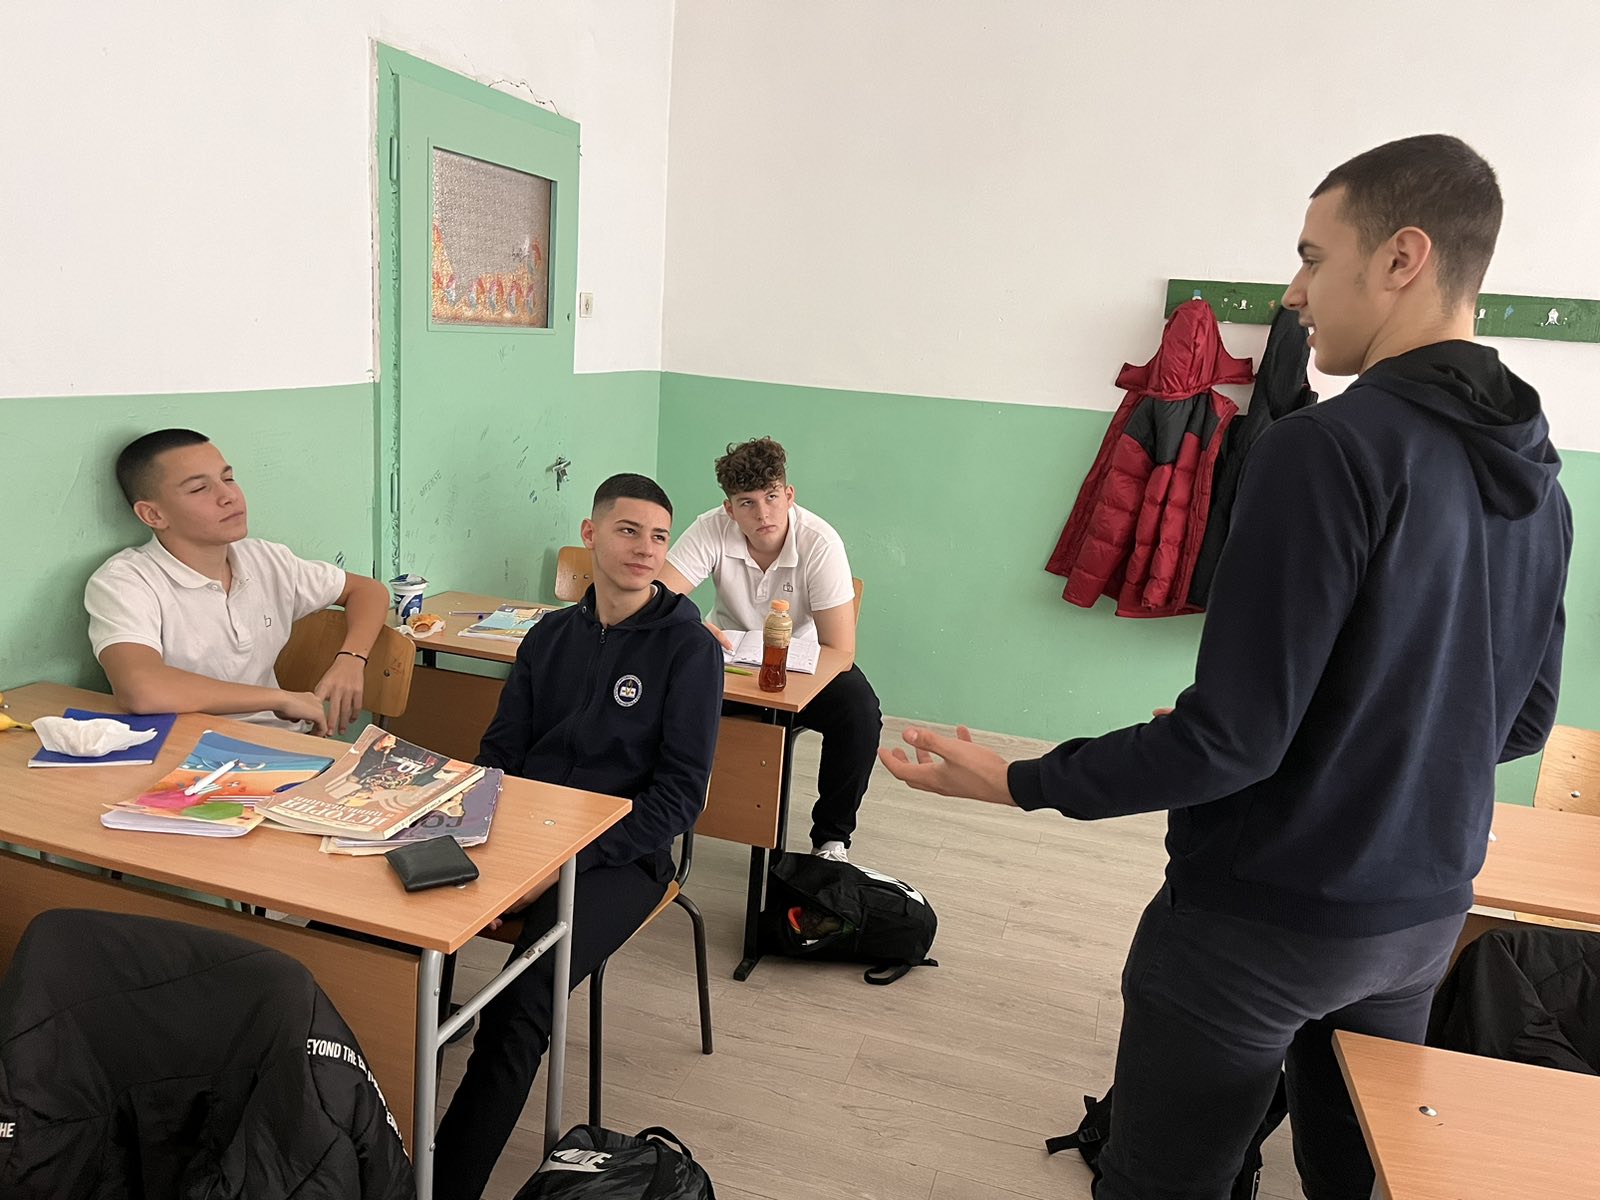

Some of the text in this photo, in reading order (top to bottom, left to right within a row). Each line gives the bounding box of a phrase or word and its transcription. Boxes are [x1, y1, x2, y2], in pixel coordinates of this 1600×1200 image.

[397, 760, 424, 774] 10
[277, 798, 389, 827] ИСТОРИЯ
[306, 1038, 357, 1066] EYOND THE
[0, 1122, 16, 1138] HE
[553, 1148, 613, 1170] NIKE
